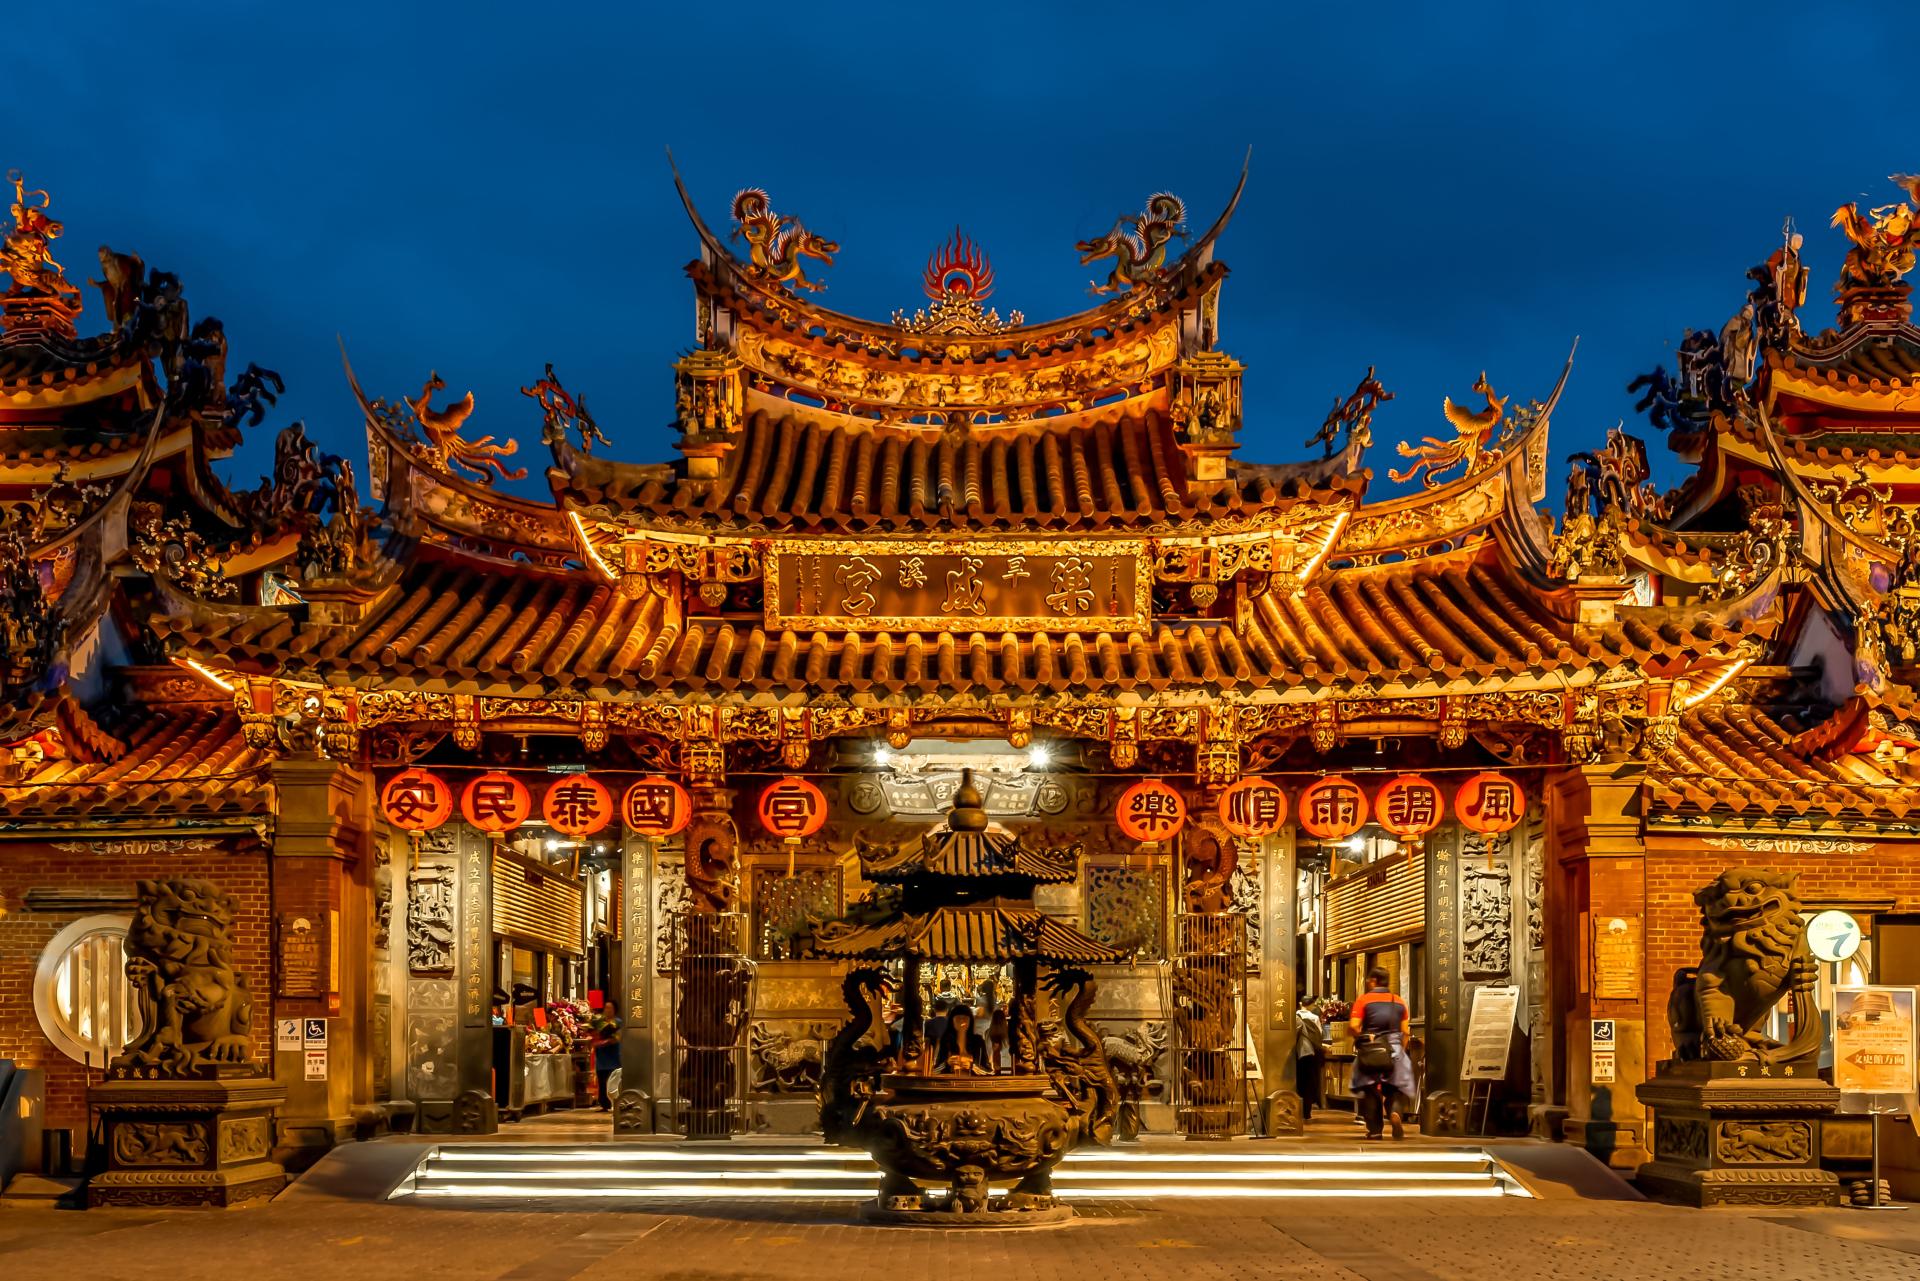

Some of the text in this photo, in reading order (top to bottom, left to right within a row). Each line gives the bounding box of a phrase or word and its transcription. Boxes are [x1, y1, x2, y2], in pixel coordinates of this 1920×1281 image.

[386, 777, 439, 824] 安
[471, 780, 517, 823] 民
[550, 782, 602, 828] 泰
[631, 783, 676, 830] 國
[765, 784, 817, 831] 宮
[1129, 790, 1181, 832] 樂
[1228, 786, 1281, 828] 順
[1309, 784, 1359, 827] 雨
[1387, 784, 1437, 828] 調
[1465, 780, 1521, 823] 風
